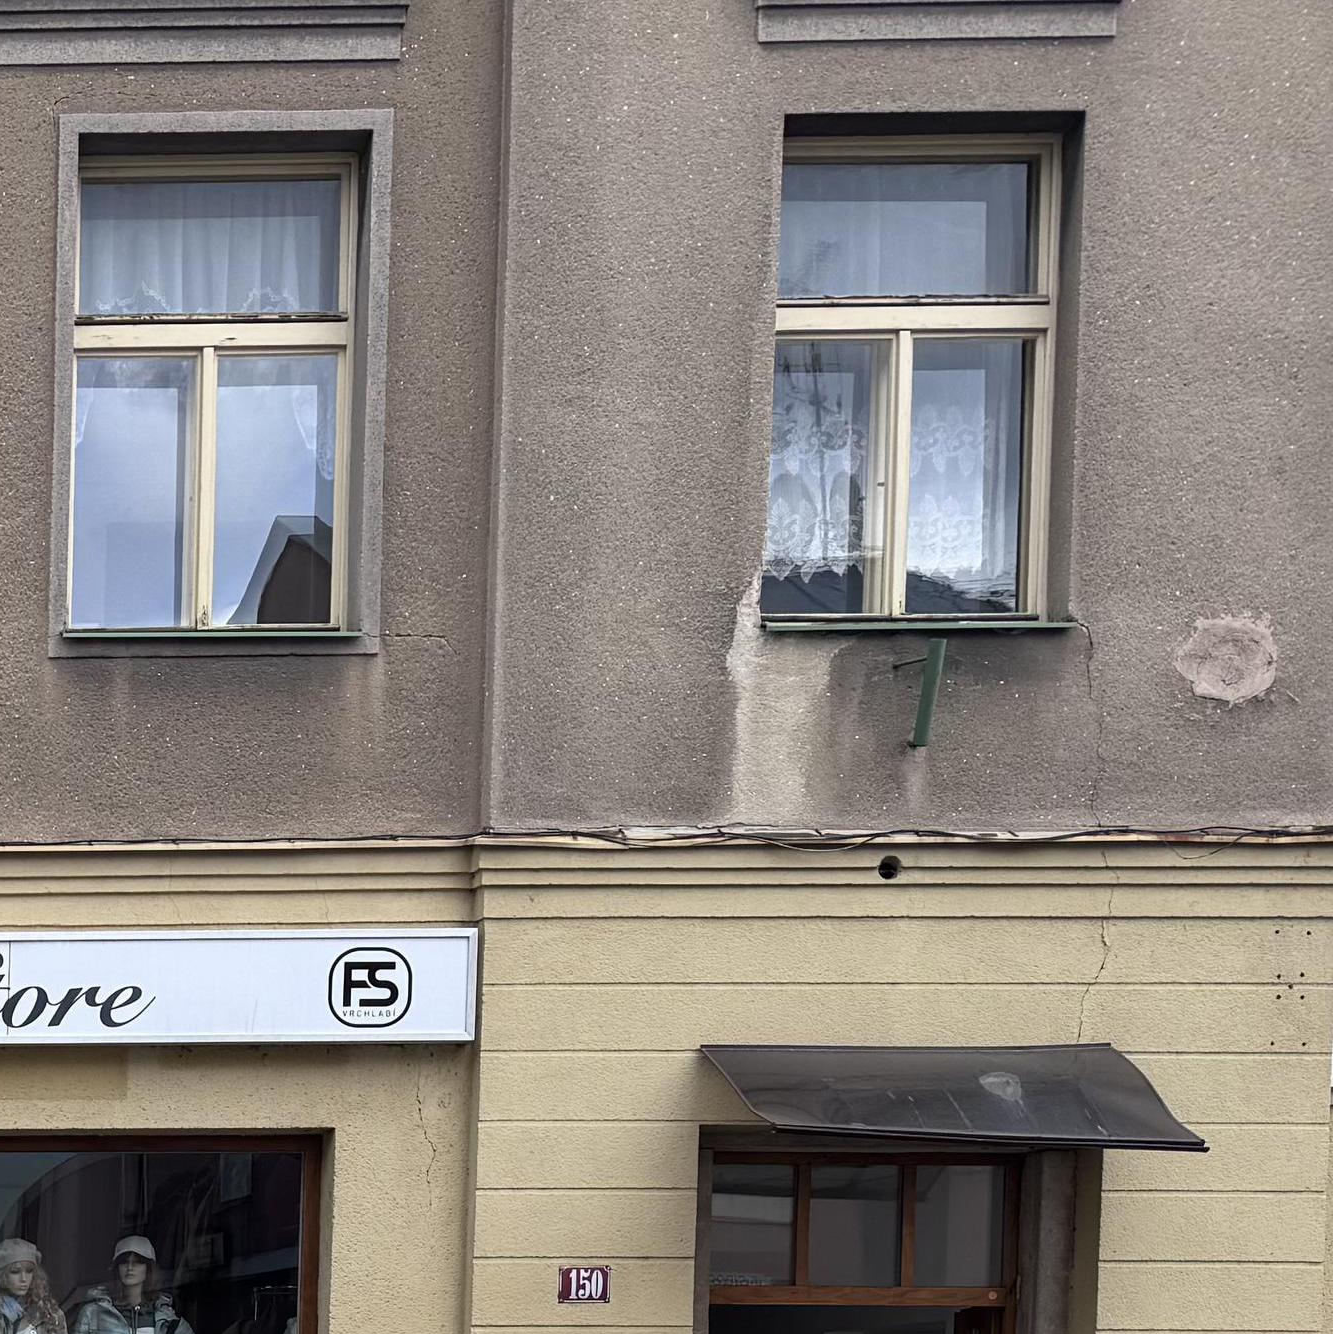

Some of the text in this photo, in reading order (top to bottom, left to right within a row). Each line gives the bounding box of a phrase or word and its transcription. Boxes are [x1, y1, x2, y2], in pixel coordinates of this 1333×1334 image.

[342, 961, 399, 1007] FS
[342, 1008, 397, 1018] VRCHLABÍ
[568, 1268, 604, 1300] 150
